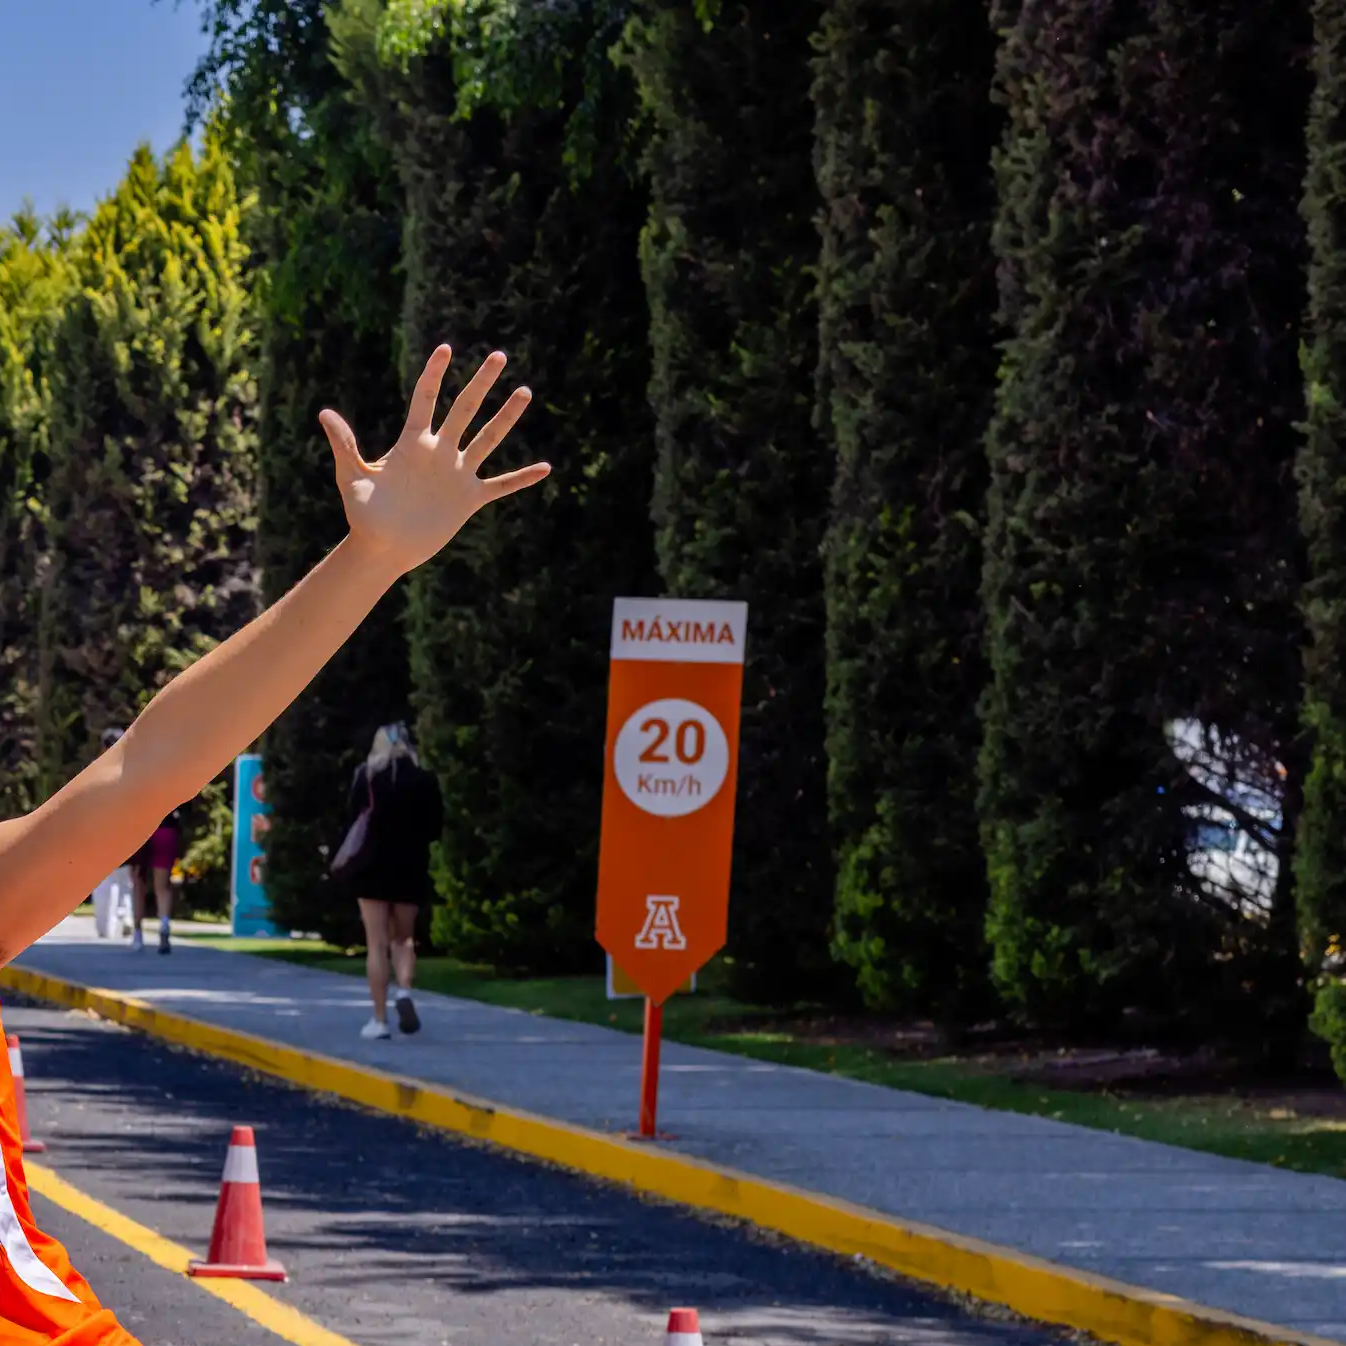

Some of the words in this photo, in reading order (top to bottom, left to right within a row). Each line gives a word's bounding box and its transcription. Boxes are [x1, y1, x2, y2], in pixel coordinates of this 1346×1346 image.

[621, 615, 736, 645] MÁXIMA
[638, 717, 706, 766] 20
[637, 773, 702, 797] Km/h
[634, 894, 687, 950] A
